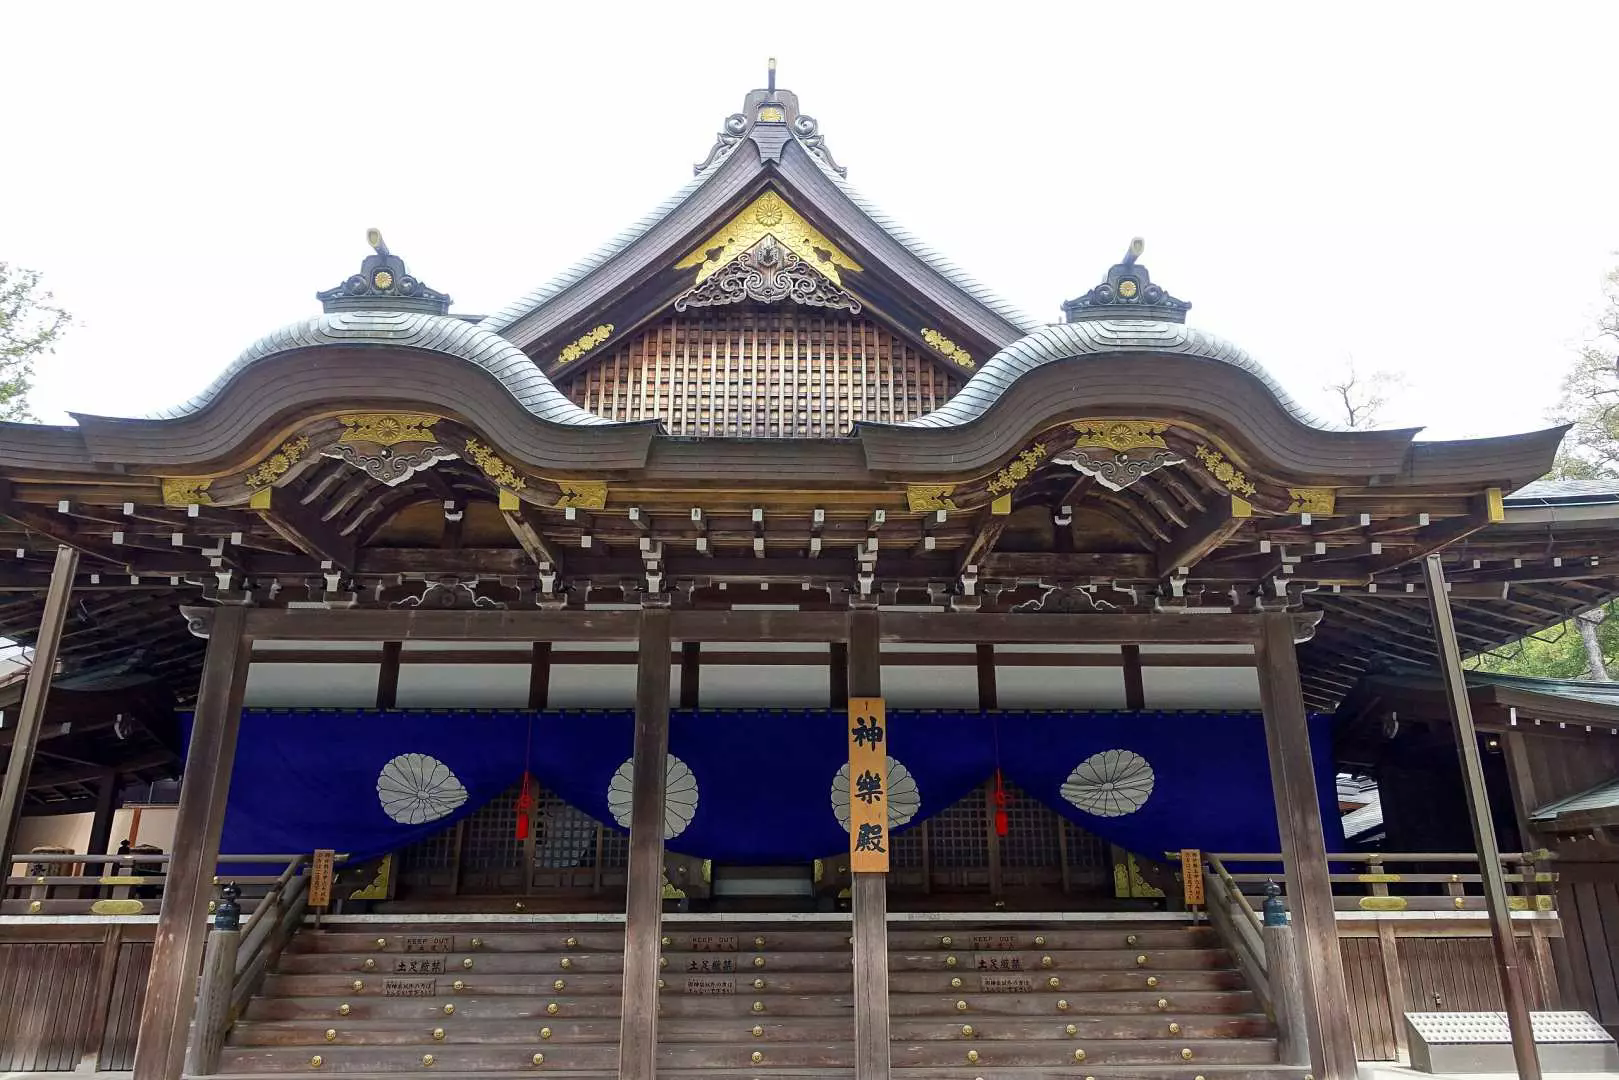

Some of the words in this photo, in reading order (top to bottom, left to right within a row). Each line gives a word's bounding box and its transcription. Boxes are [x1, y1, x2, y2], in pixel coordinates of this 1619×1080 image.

[851, 715, 886, 853] 神樂殿
[433, 937, 449, 945] OUT
